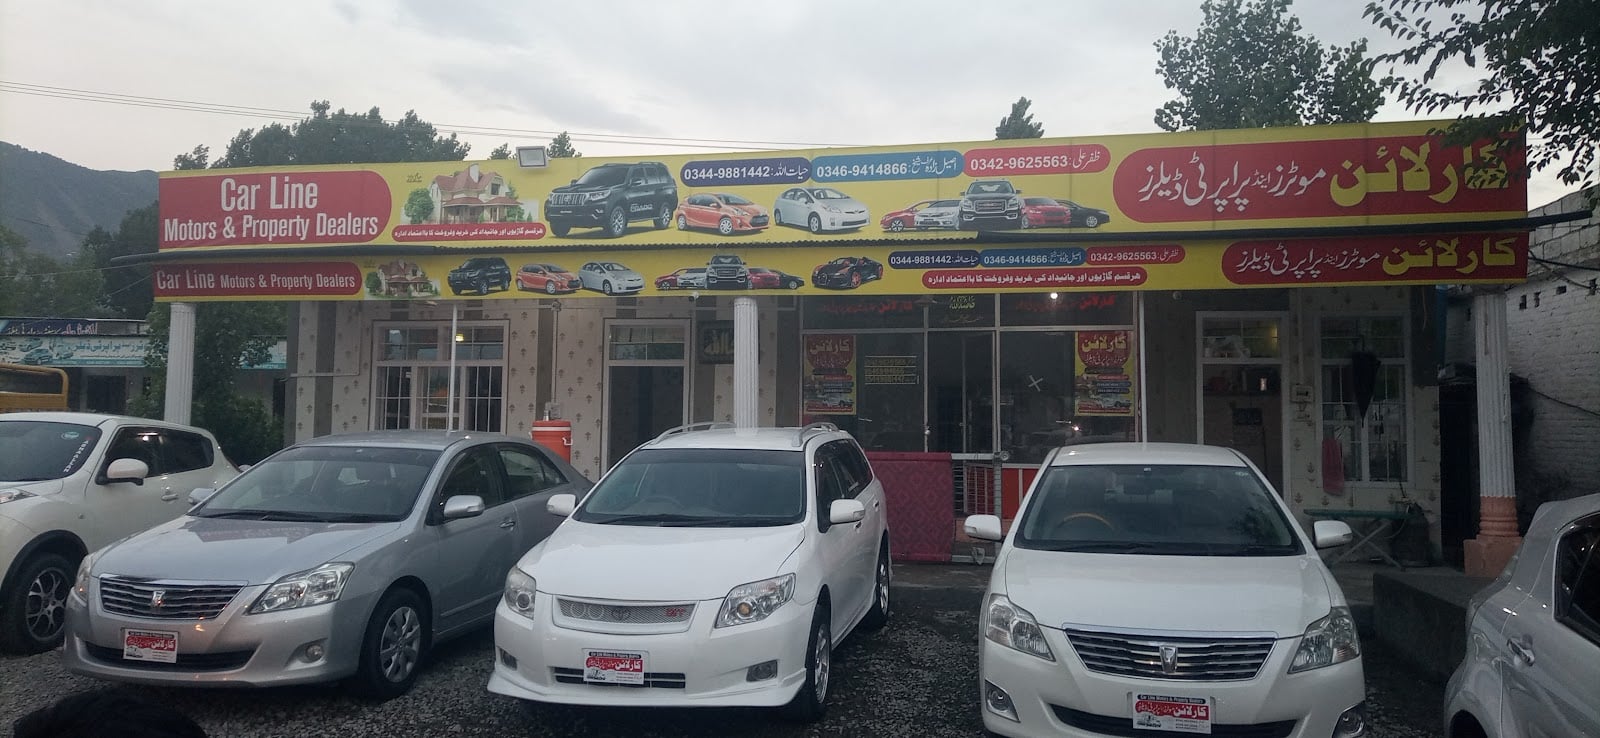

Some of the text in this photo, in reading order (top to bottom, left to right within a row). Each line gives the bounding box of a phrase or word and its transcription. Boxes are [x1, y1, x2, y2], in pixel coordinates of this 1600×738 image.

[1080, 151, 1100, 170] ظفر
[1138, 160, 1183, 202] ڈیلرز
[1268, 160, 1327, 197] موٹرز
[220, 176, 318, 212] Car Line
[164, 212, 378, 242] Motors & Property Dealers
[1236, 248, 1270, 273] ڈیلرز
[1336, 248, 1380, 270] موٹرز
[156, 270, 355, 290] Car Line Motors & Property Dealers
[928, 276, 944, 284] ادارہ
[976, 274, 982, 282] کا
[1014, 274, 1032, 283] خرید
[1034, 274, 1046, 283] کی
[1077, 272, 1087, 282] اور
